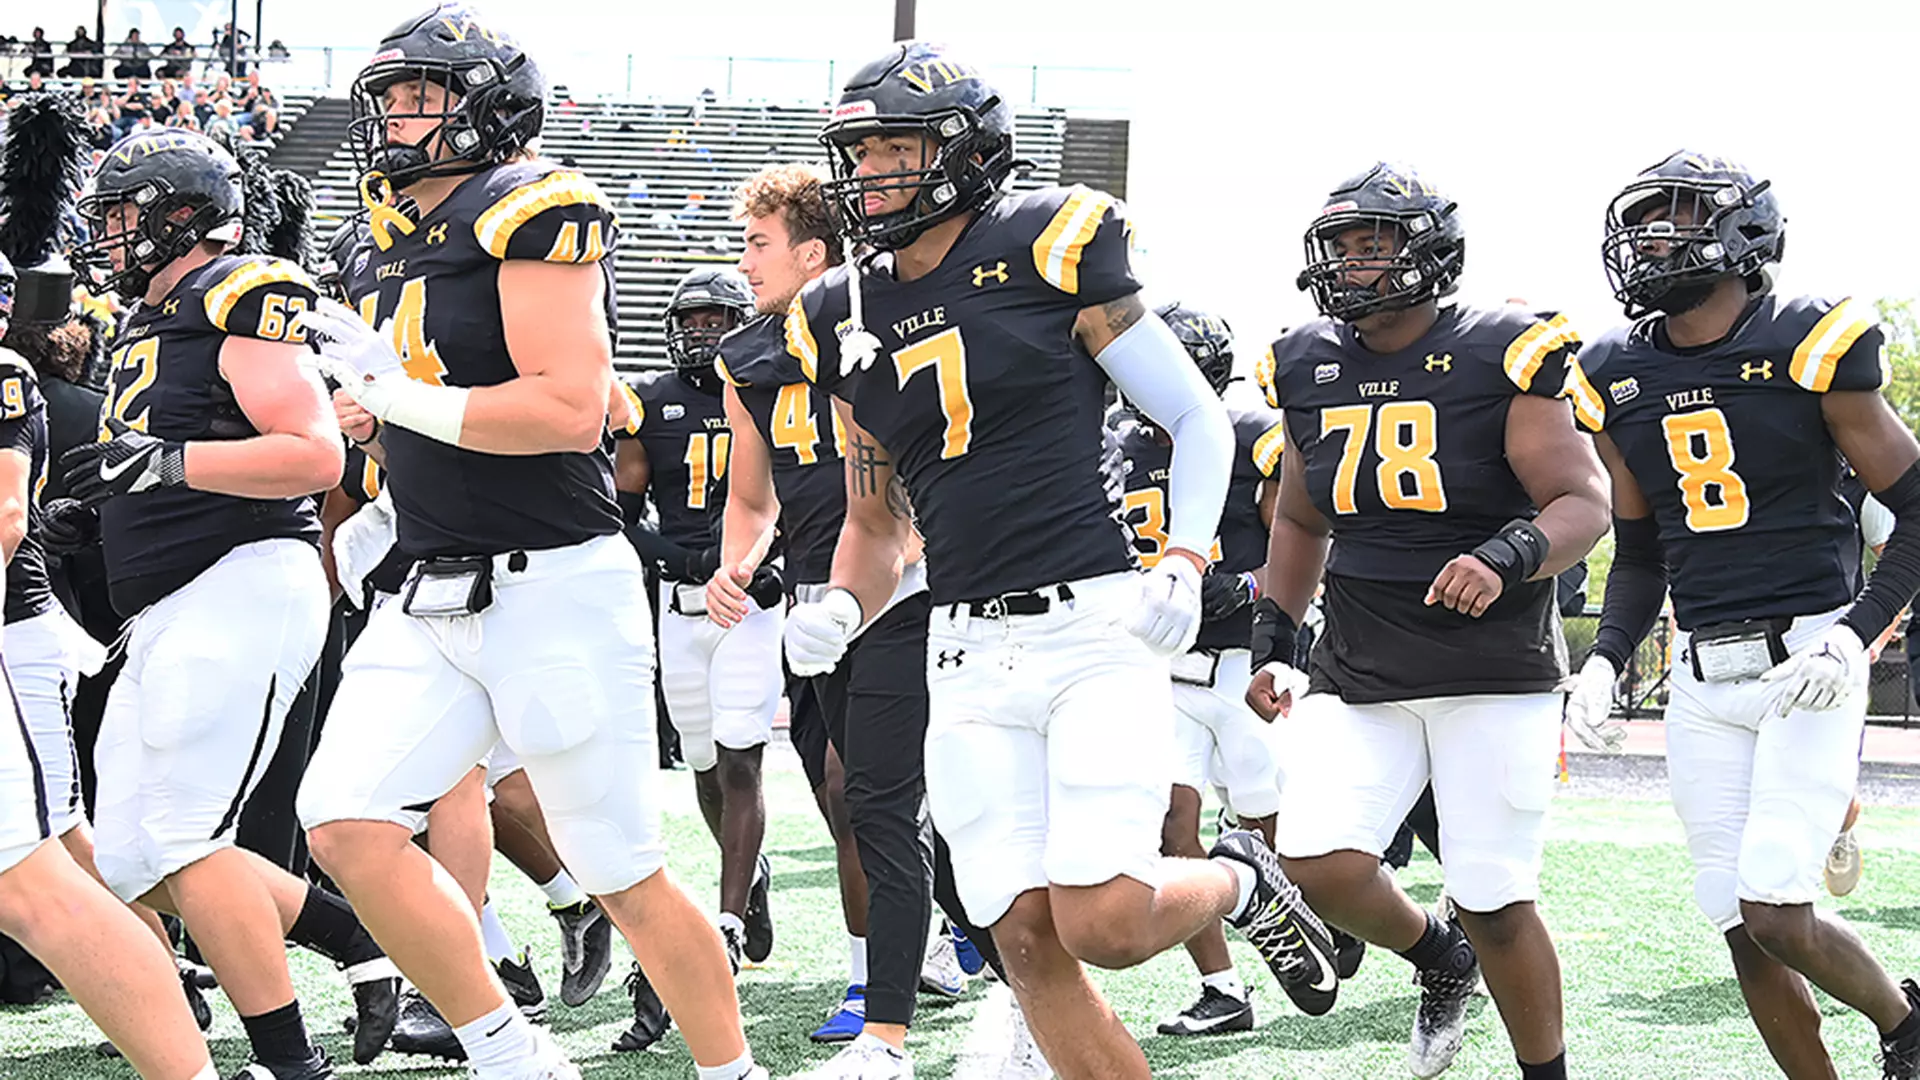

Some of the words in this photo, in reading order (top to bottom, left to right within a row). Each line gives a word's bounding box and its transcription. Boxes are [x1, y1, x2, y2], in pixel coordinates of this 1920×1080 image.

[892, 306, 947, 340] VILLE
[890, 325, 974, 461] 7
[1357, 380, 1400, 398] VILLE
[1665, 387, 1714, 411] VILLE
[1319, 400, 1448, 515] 78
[1661, 407, 1750, 533] 8
